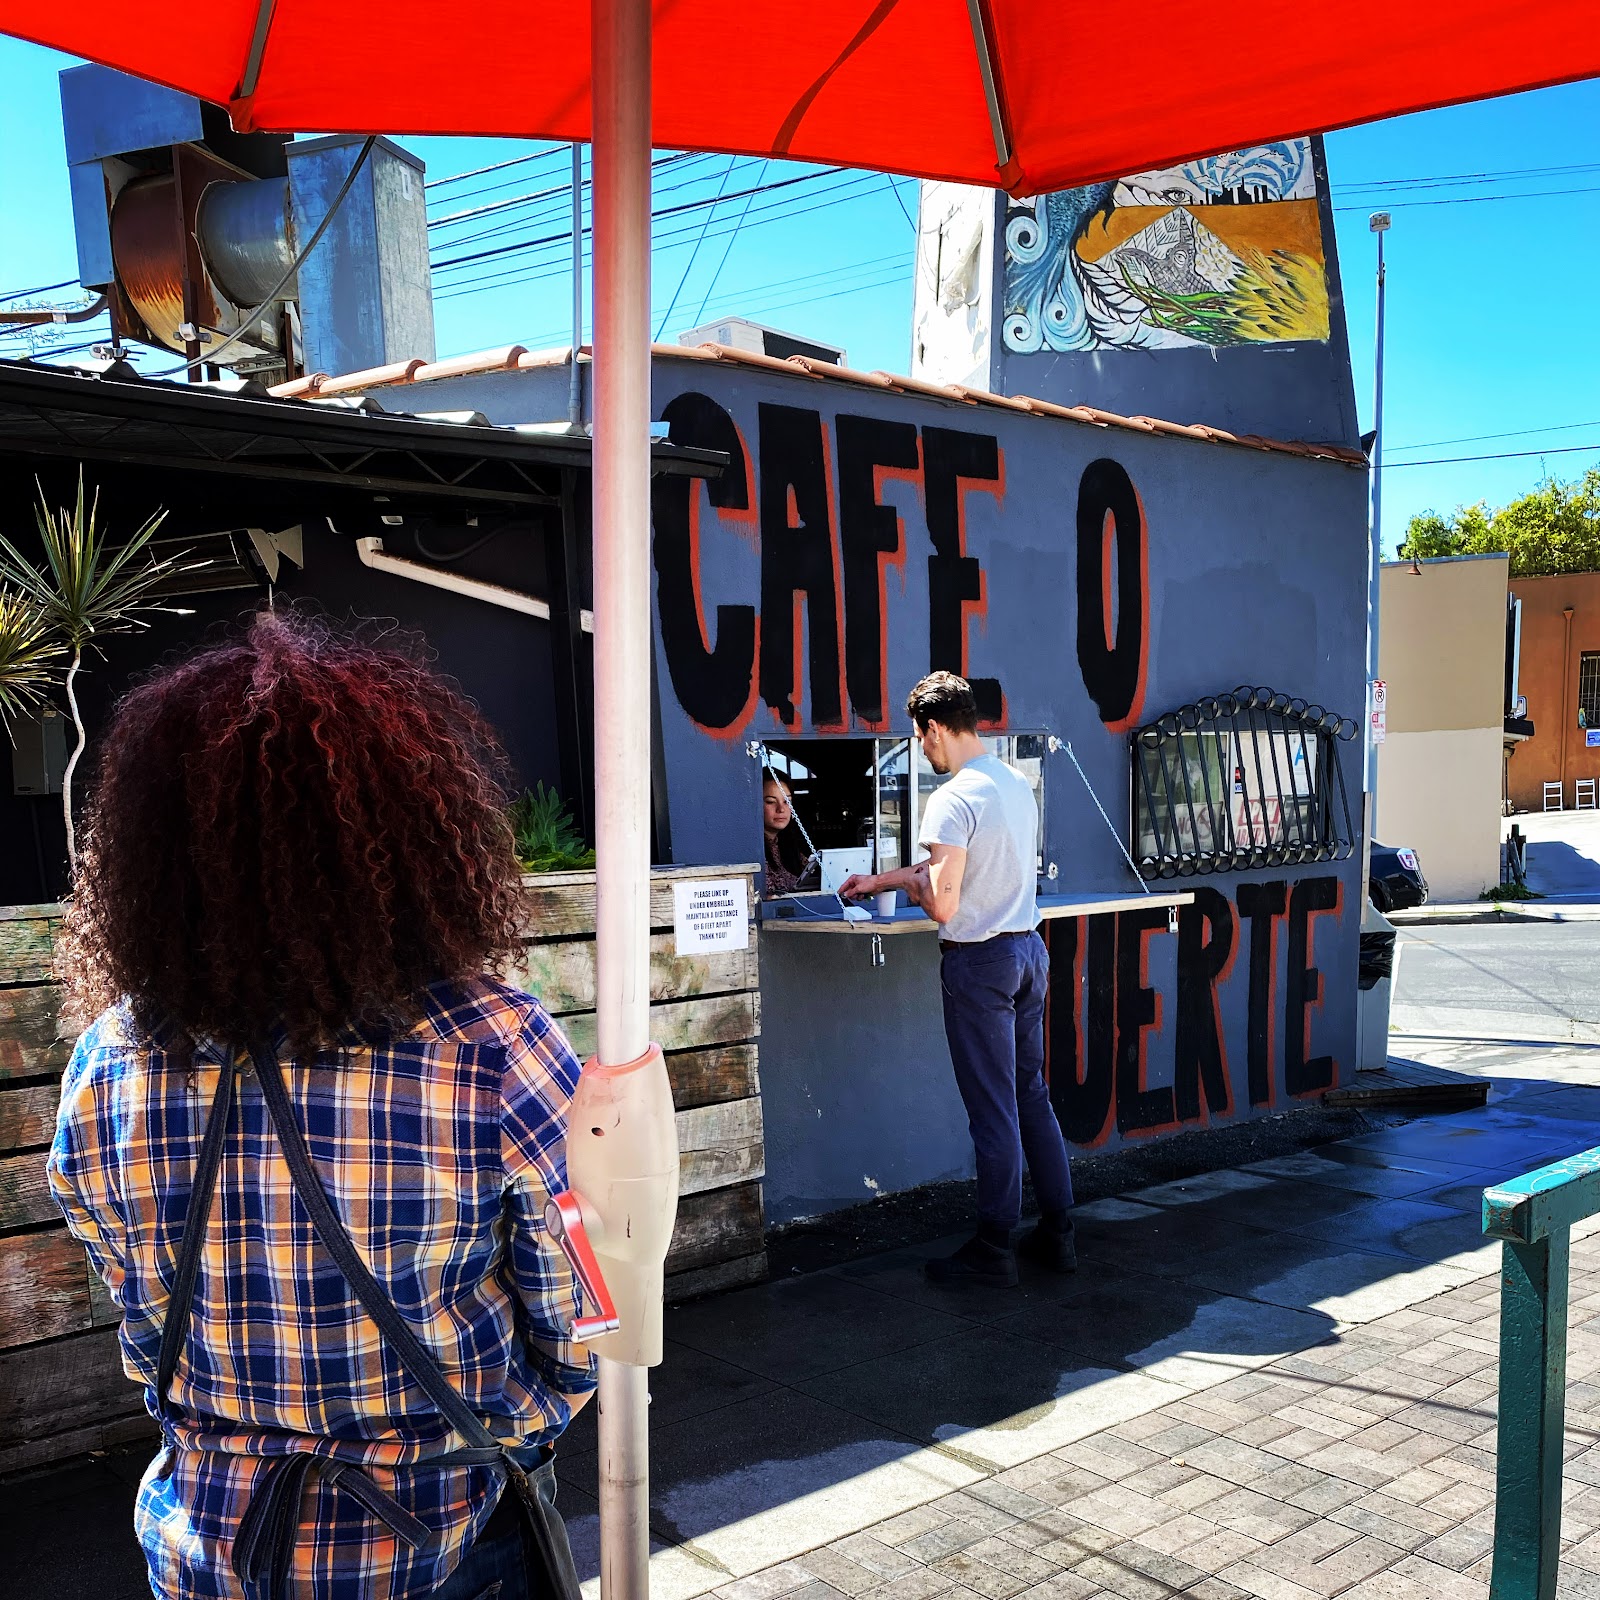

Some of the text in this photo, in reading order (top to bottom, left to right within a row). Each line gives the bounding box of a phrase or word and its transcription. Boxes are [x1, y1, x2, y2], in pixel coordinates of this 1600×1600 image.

[651, 392, 1150, 737] CAFE O
[711, 889, 721, 897] LINE
[689, 899, 734, 909] UNDER UMBRELLAS
[685, 912, 709, 920] MAINTAIN
[715, 909, 738, 917] DISTANCE
[705, 922, 715, 930] FEET
[1044, 876, 1345, 1147] UERTE
